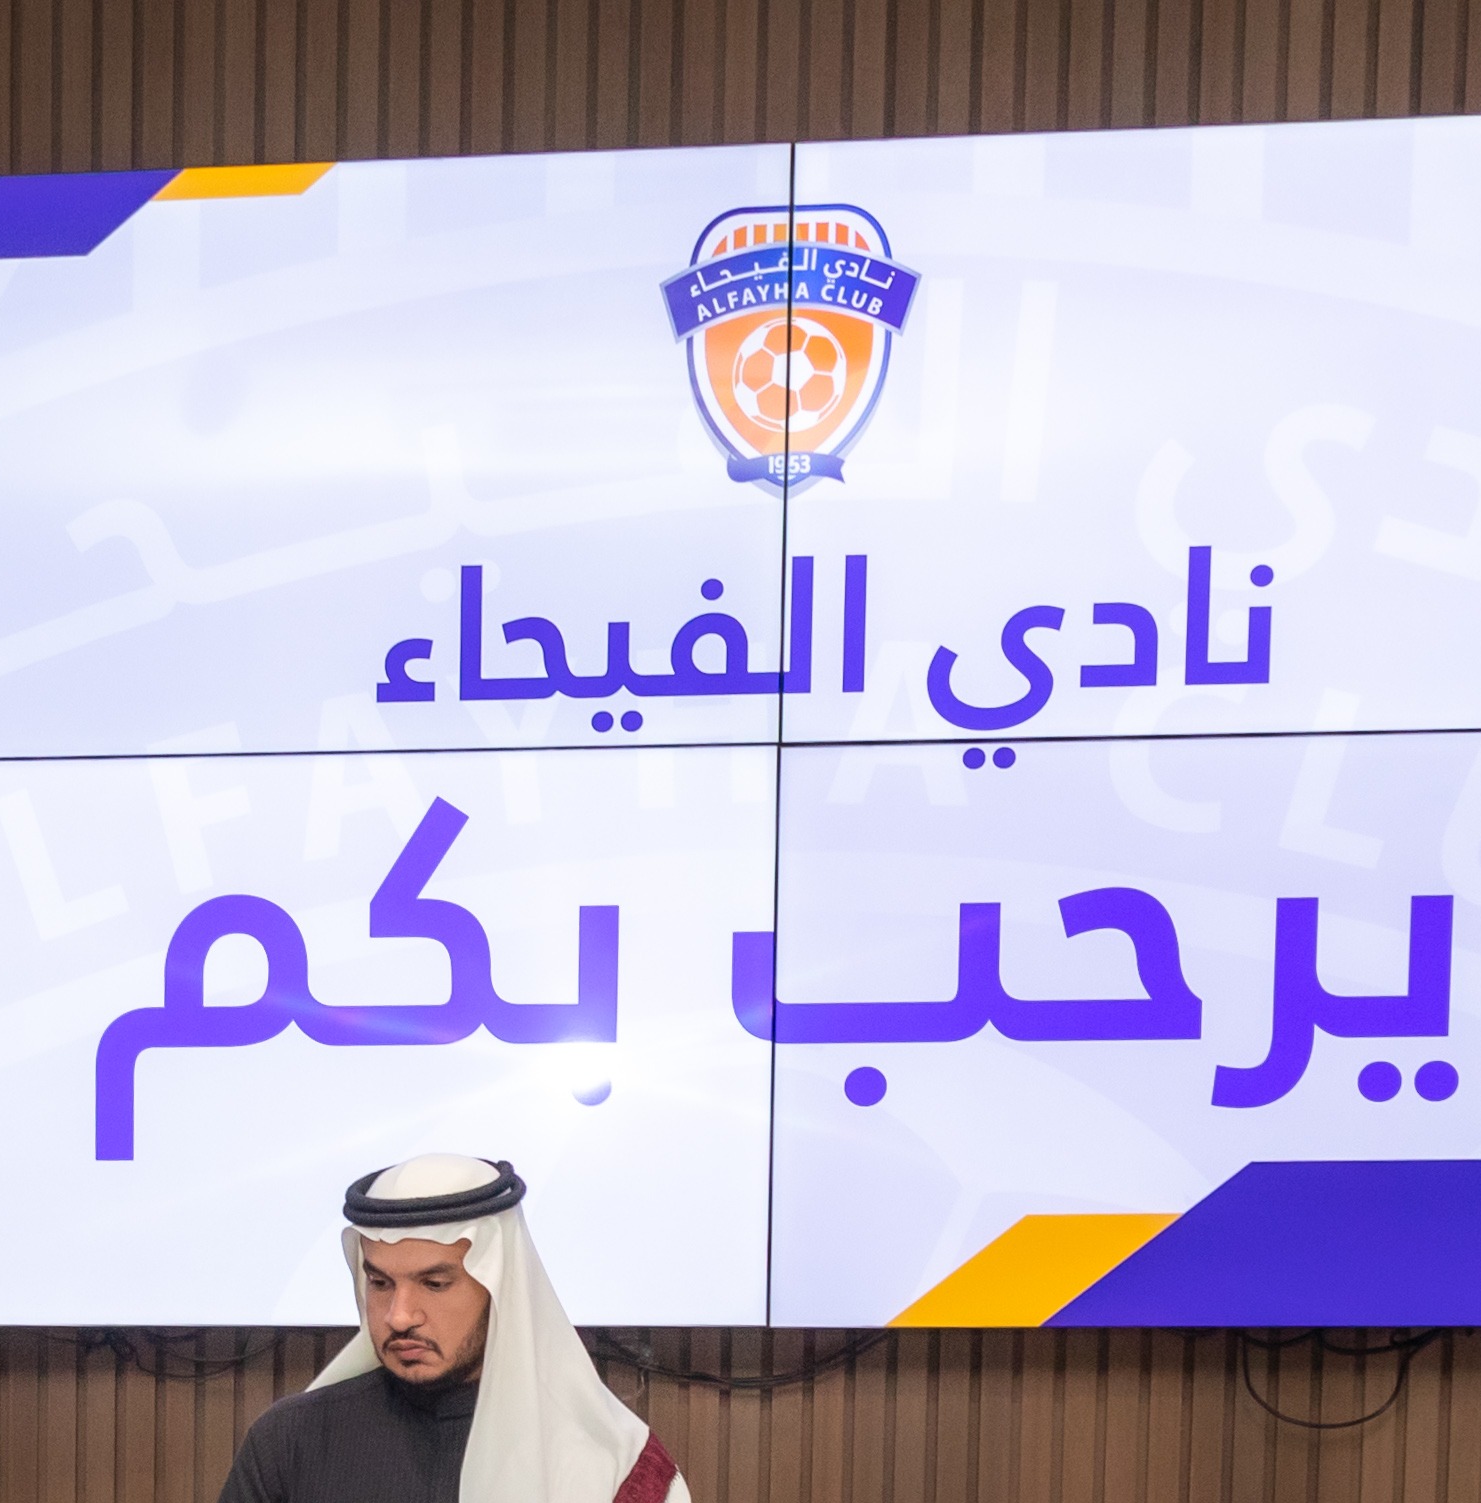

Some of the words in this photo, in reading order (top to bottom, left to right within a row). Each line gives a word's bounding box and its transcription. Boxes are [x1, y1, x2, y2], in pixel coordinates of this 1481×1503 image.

[689, 248, 818, 297] الفيحاء
[696, 281, 810, 322] ALFAYHA
[820, 282, 884, 316] CLUB
[823, 259, 896, 291] نادي
[767, 454, 812, 475] 1953
[376, 553, 868, 733] الفيحاء
[926, 544, 1275, 770] نادي
[94, 795, 620, 1161] بكم
[731, 886, 1460, 1109] يرحب
